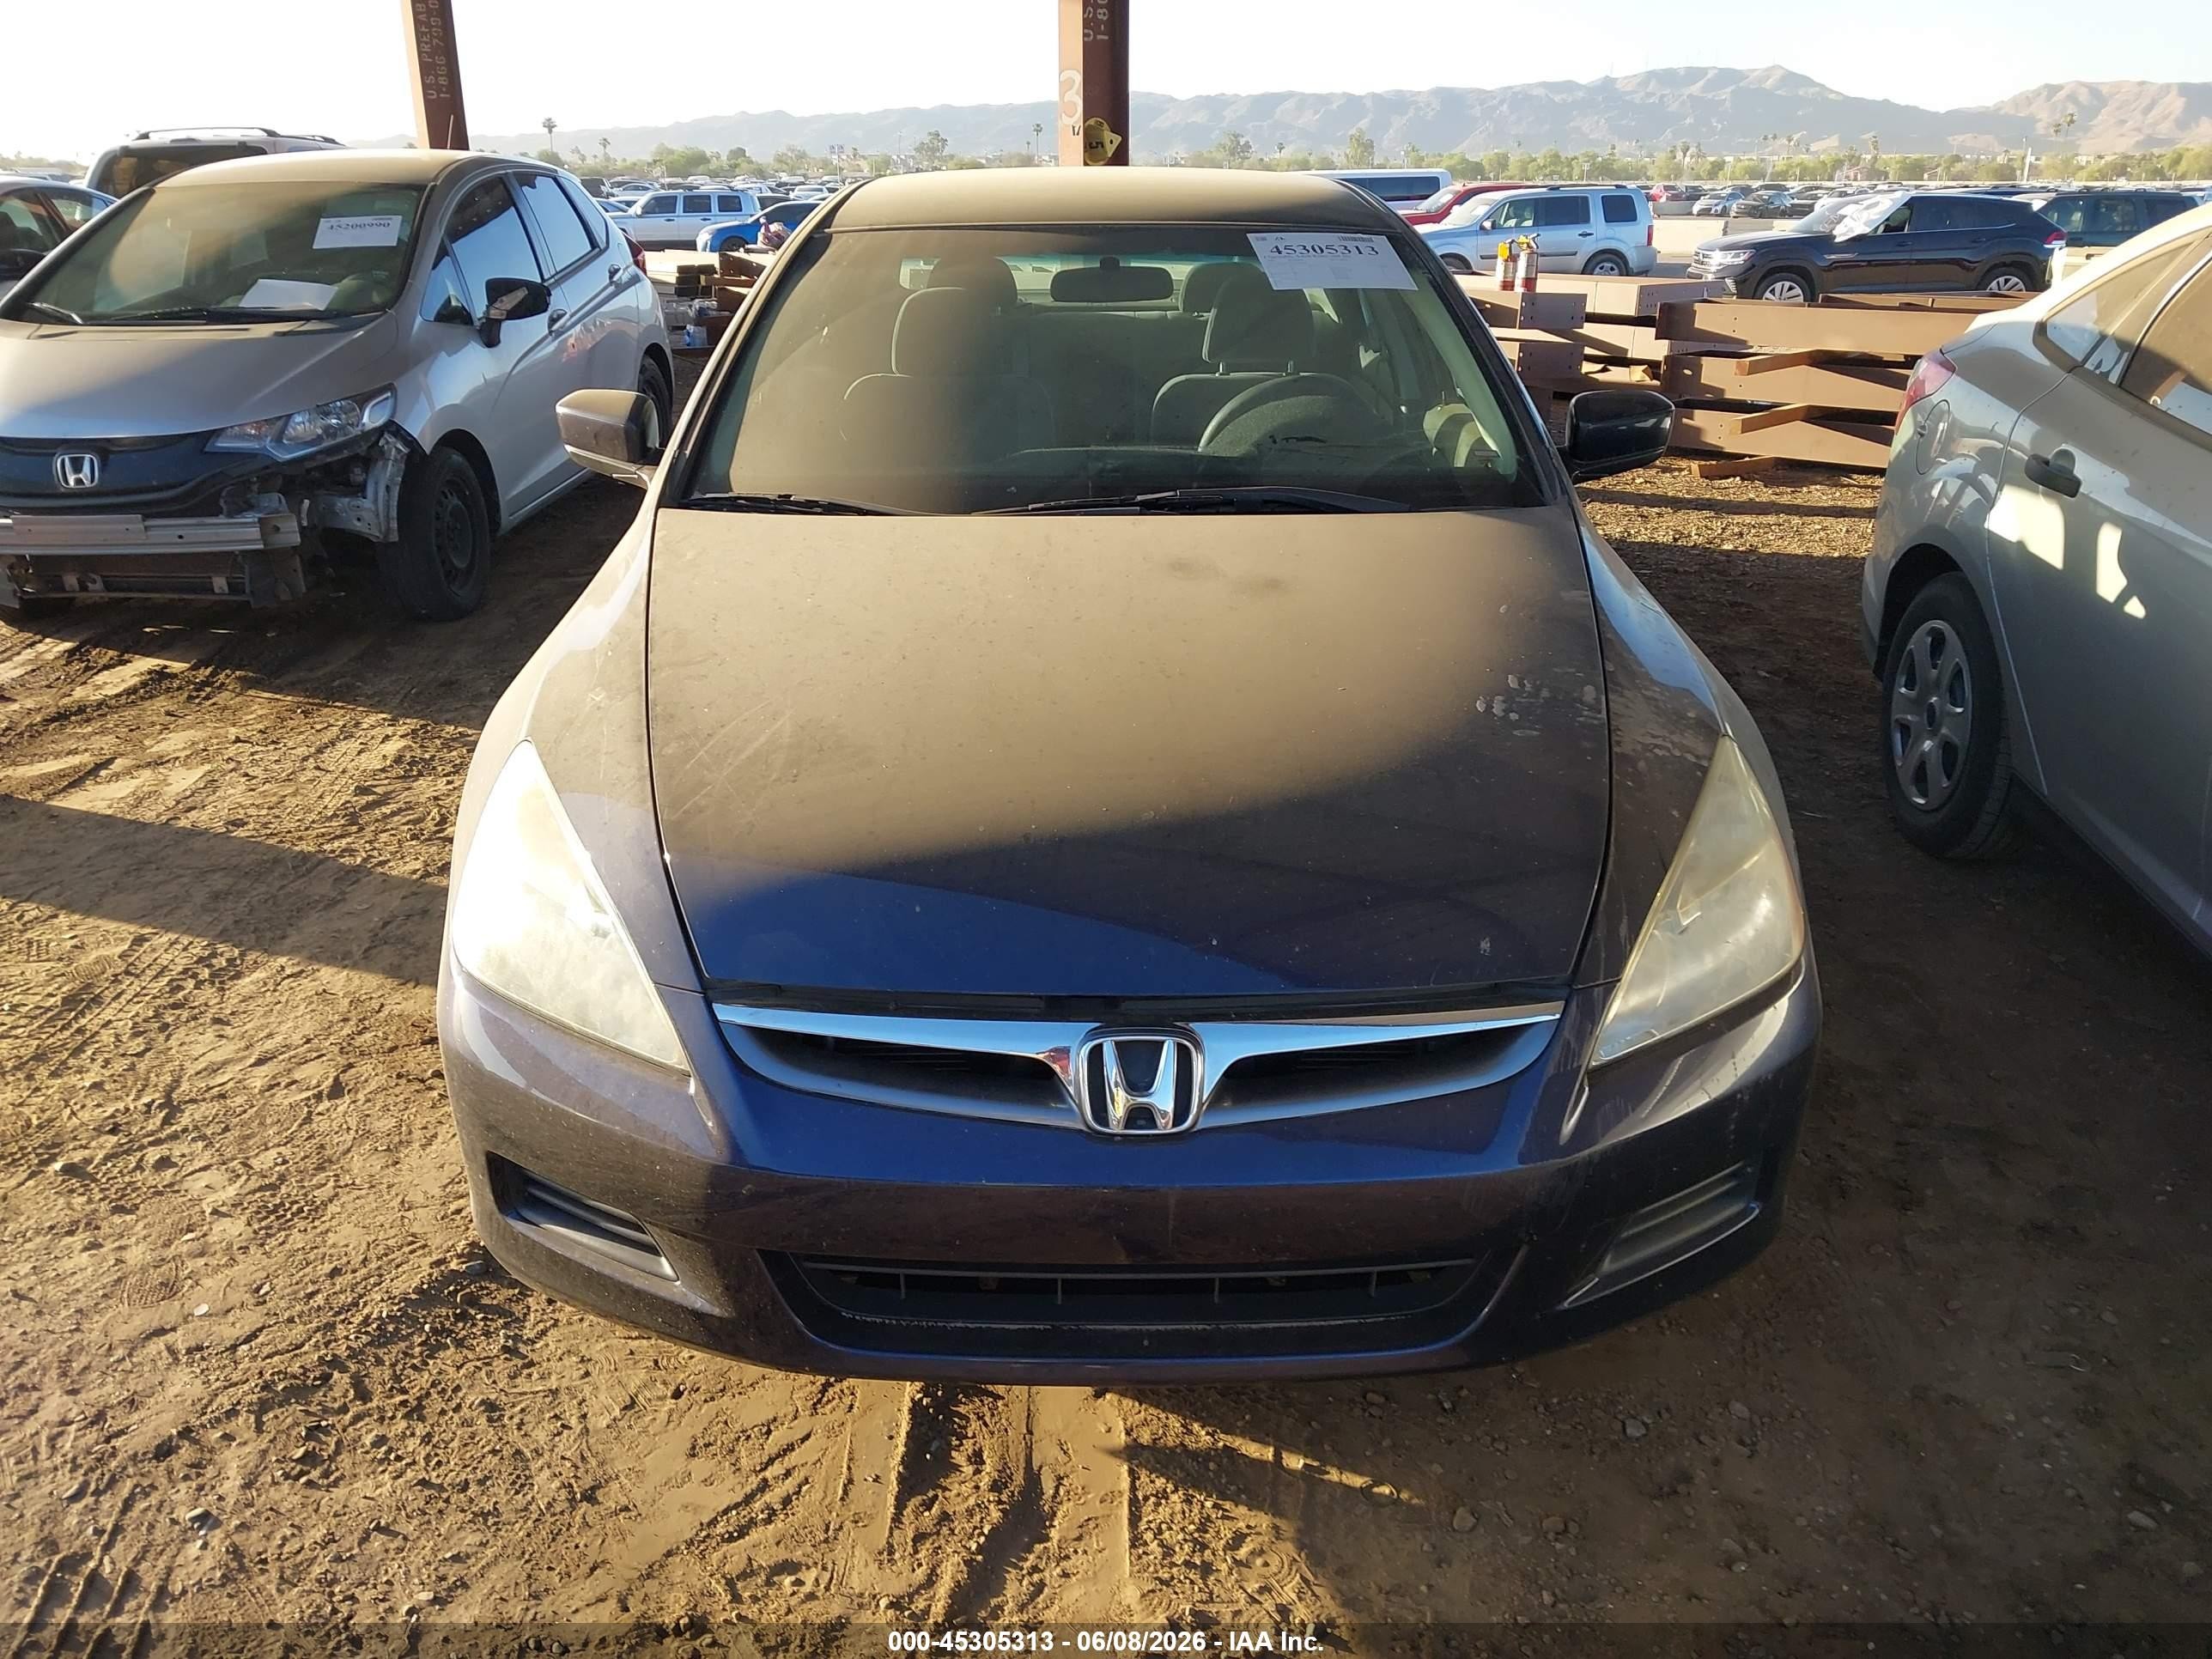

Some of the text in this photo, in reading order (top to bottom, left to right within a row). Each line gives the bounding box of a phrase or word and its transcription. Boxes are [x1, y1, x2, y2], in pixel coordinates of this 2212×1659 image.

[416, 3, 433, 62] PREFAB
[1060, 69, 1081, 125] 3
[1270, 244, 1380, 256] 45305313
